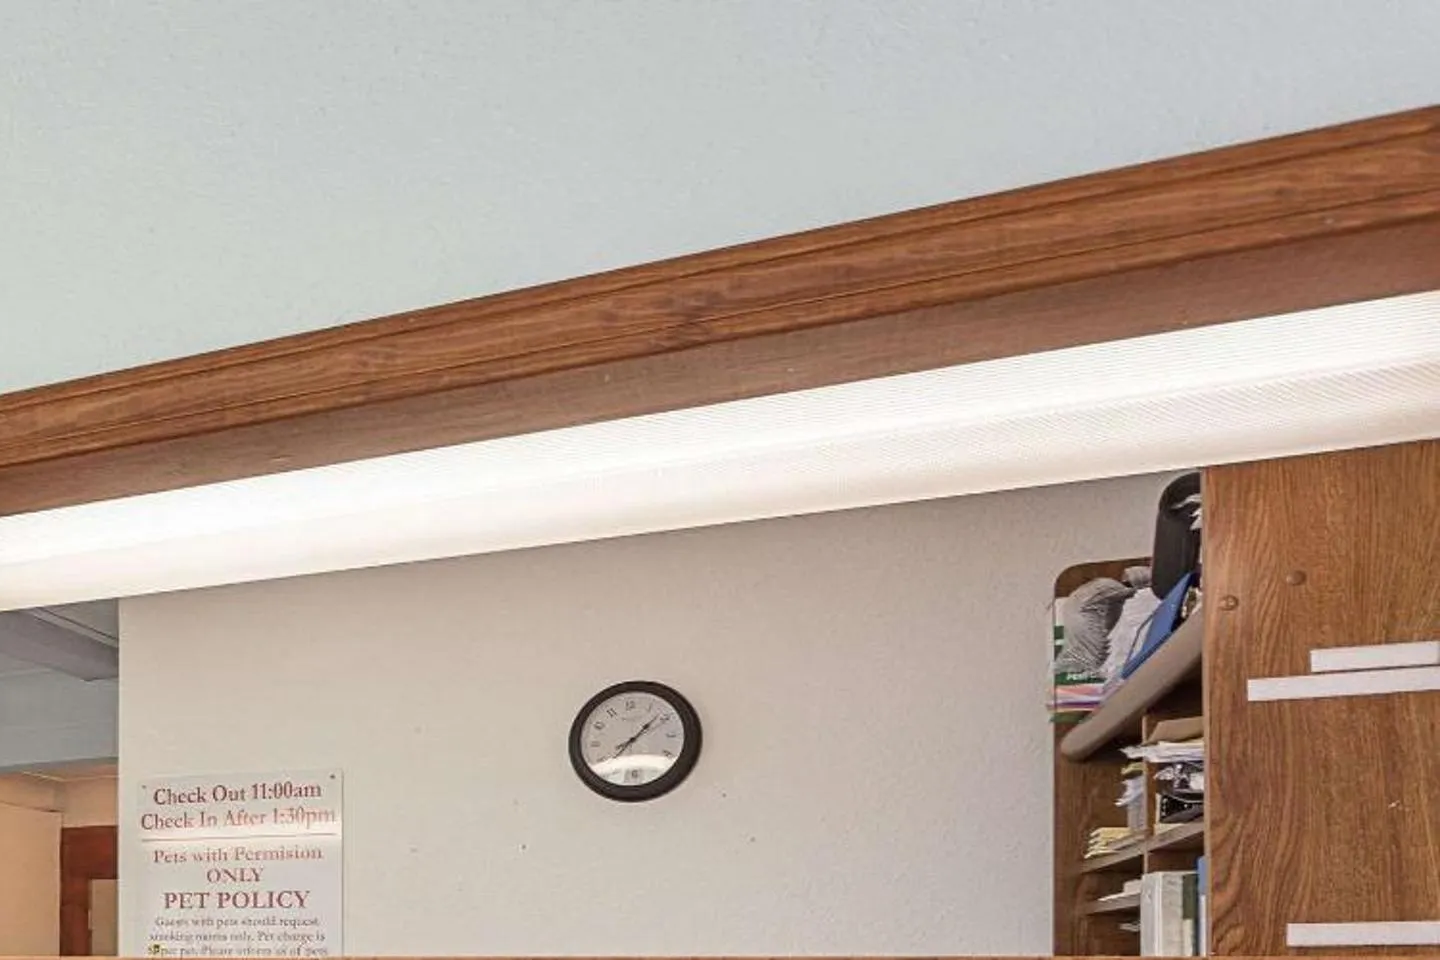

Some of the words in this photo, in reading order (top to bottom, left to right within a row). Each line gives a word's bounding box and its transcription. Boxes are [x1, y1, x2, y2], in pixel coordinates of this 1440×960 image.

[153, 787, 207, 806] Check
[212, 784, 246, 802] Out
[251, 781, 322, 800] 11:00am
[141, 812, 196, 830] Check
[200, 811, 218, 827] In
[223, 809, 268, 826] After
[273, 806, 335, 830] 1:30pm
[153, 849, 188, 864] Pets
[192, 847, 228, 862] with
[206, 867, 264, 883] ONLY
[164, 892, 210, 909] PET
[217, 890, 310, 909] POLICY
